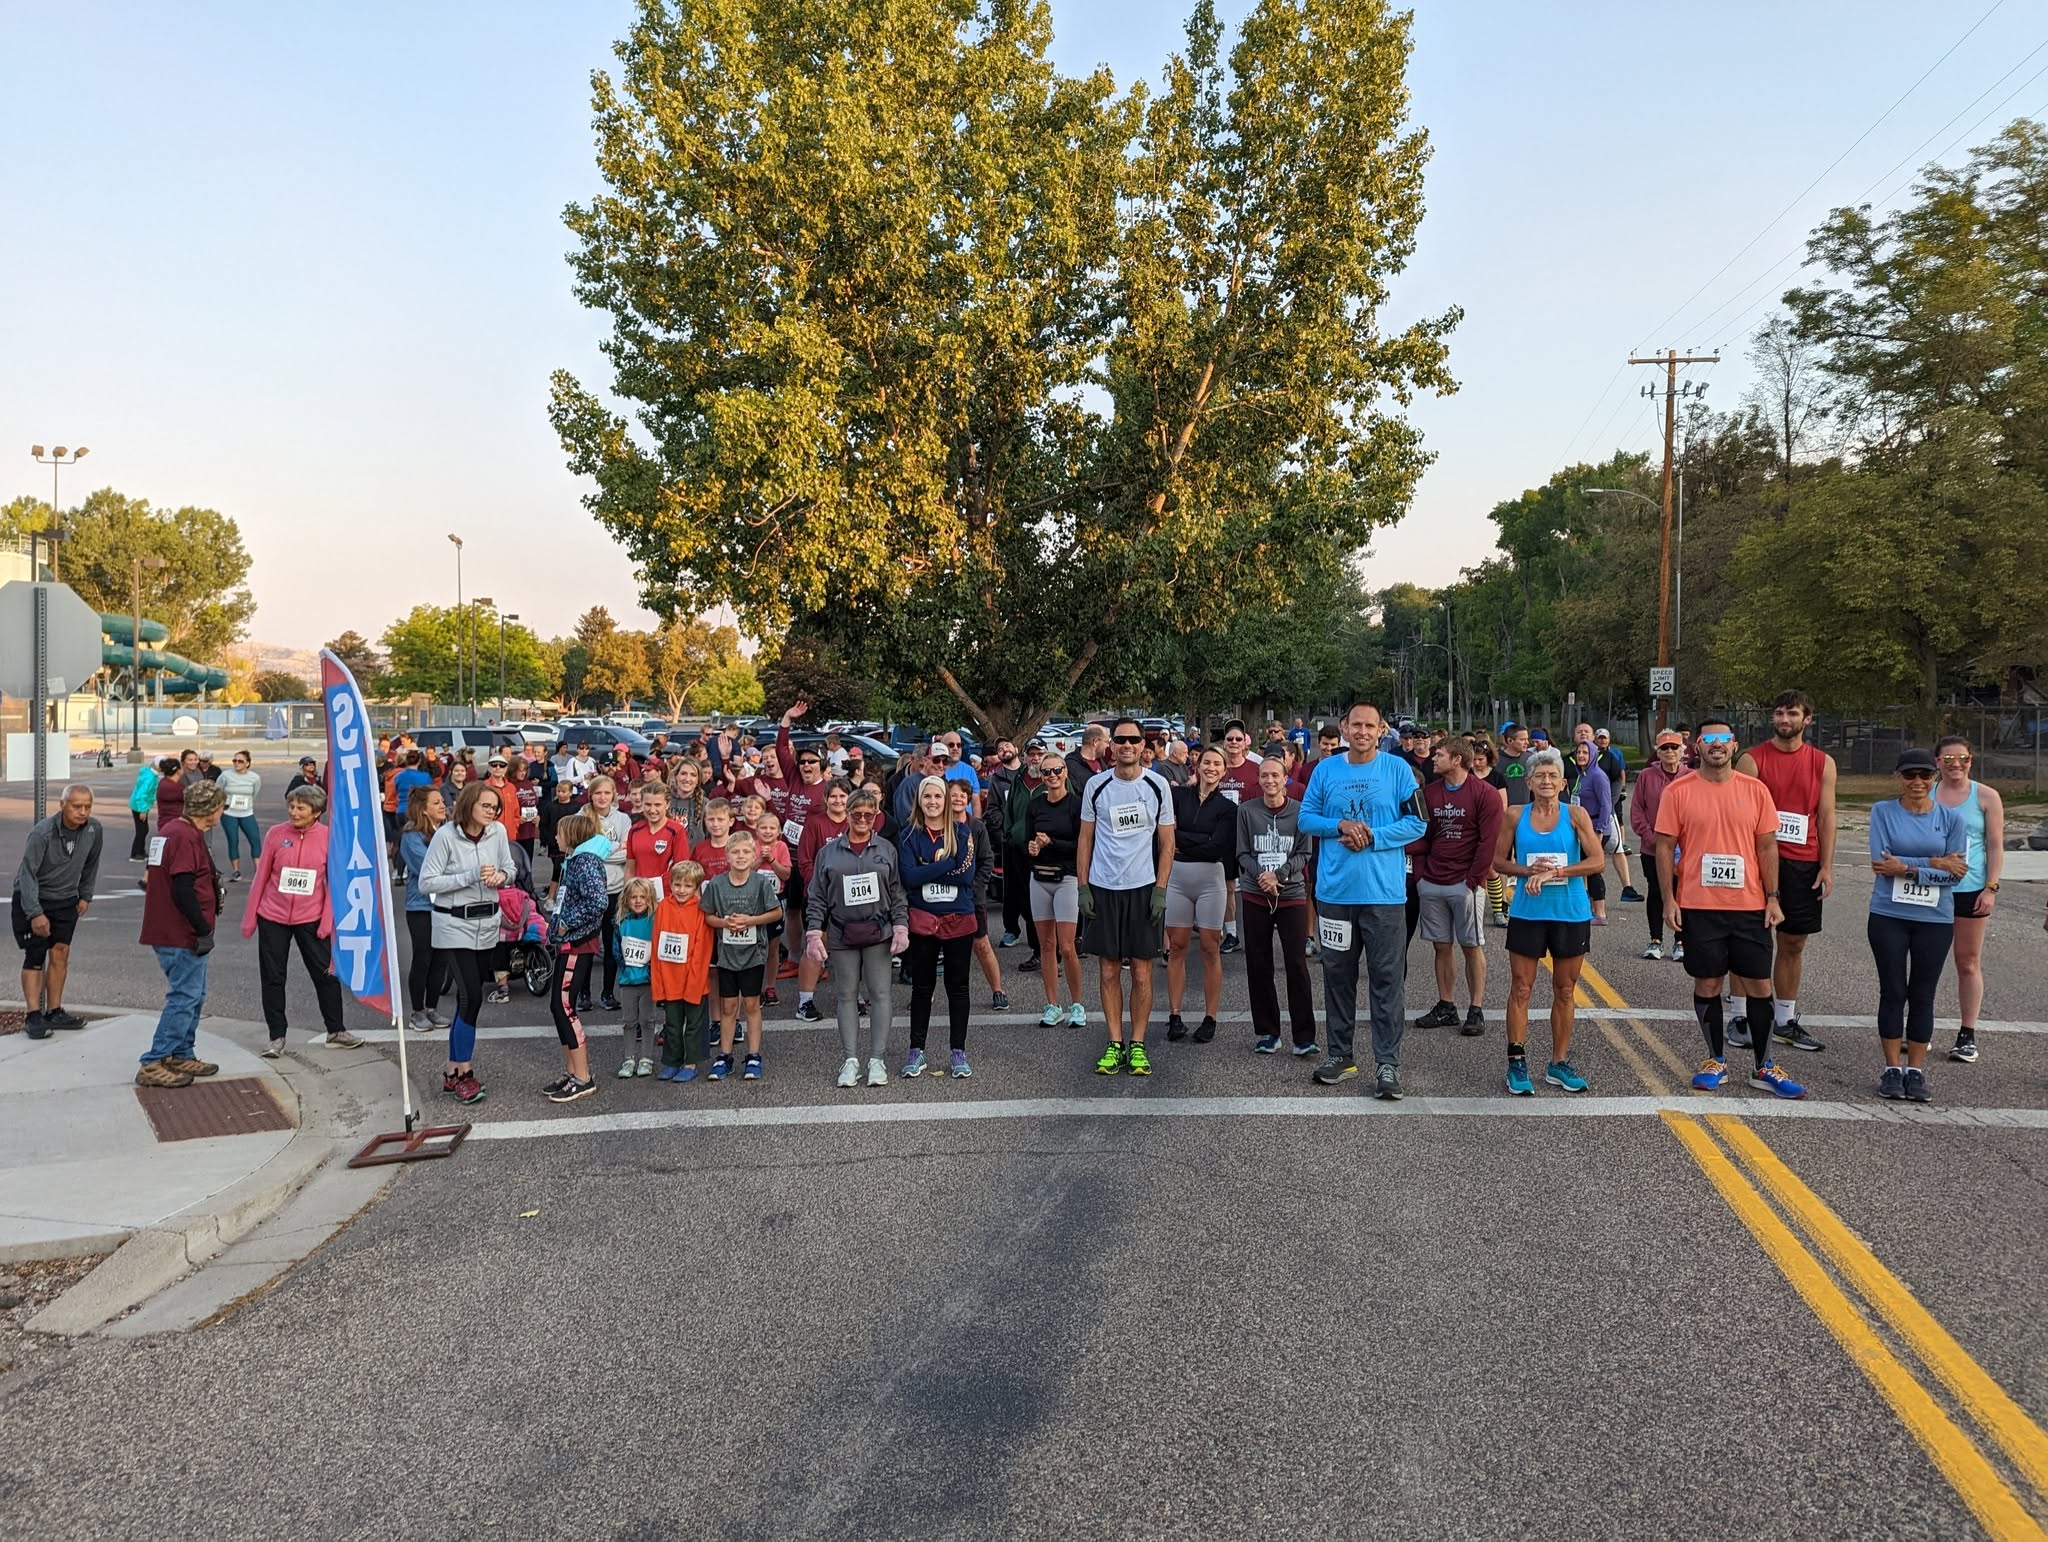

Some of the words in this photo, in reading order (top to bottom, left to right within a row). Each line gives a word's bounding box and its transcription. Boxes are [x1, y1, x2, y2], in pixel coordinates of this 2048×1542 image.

[1652, 681, 1672, 692] 20
[1218, 781, 1245, 790] Simplot
[1433, 807, 1466, 819] Simplot
[1118, 813, 1139, 827] 9047
[1711, 867, 1737, 879] 9241
[287, 877, 308, 889] 9049
[851, 884, 872, 898] 9104
[930, 884, 951, 895] 9180
[1903, 882, 1930, 897] 9115
[1323, 929, 1343, 943] 9178
[624, 947, 645, 960] 9146
[664, 943, 682, 956] 9143
